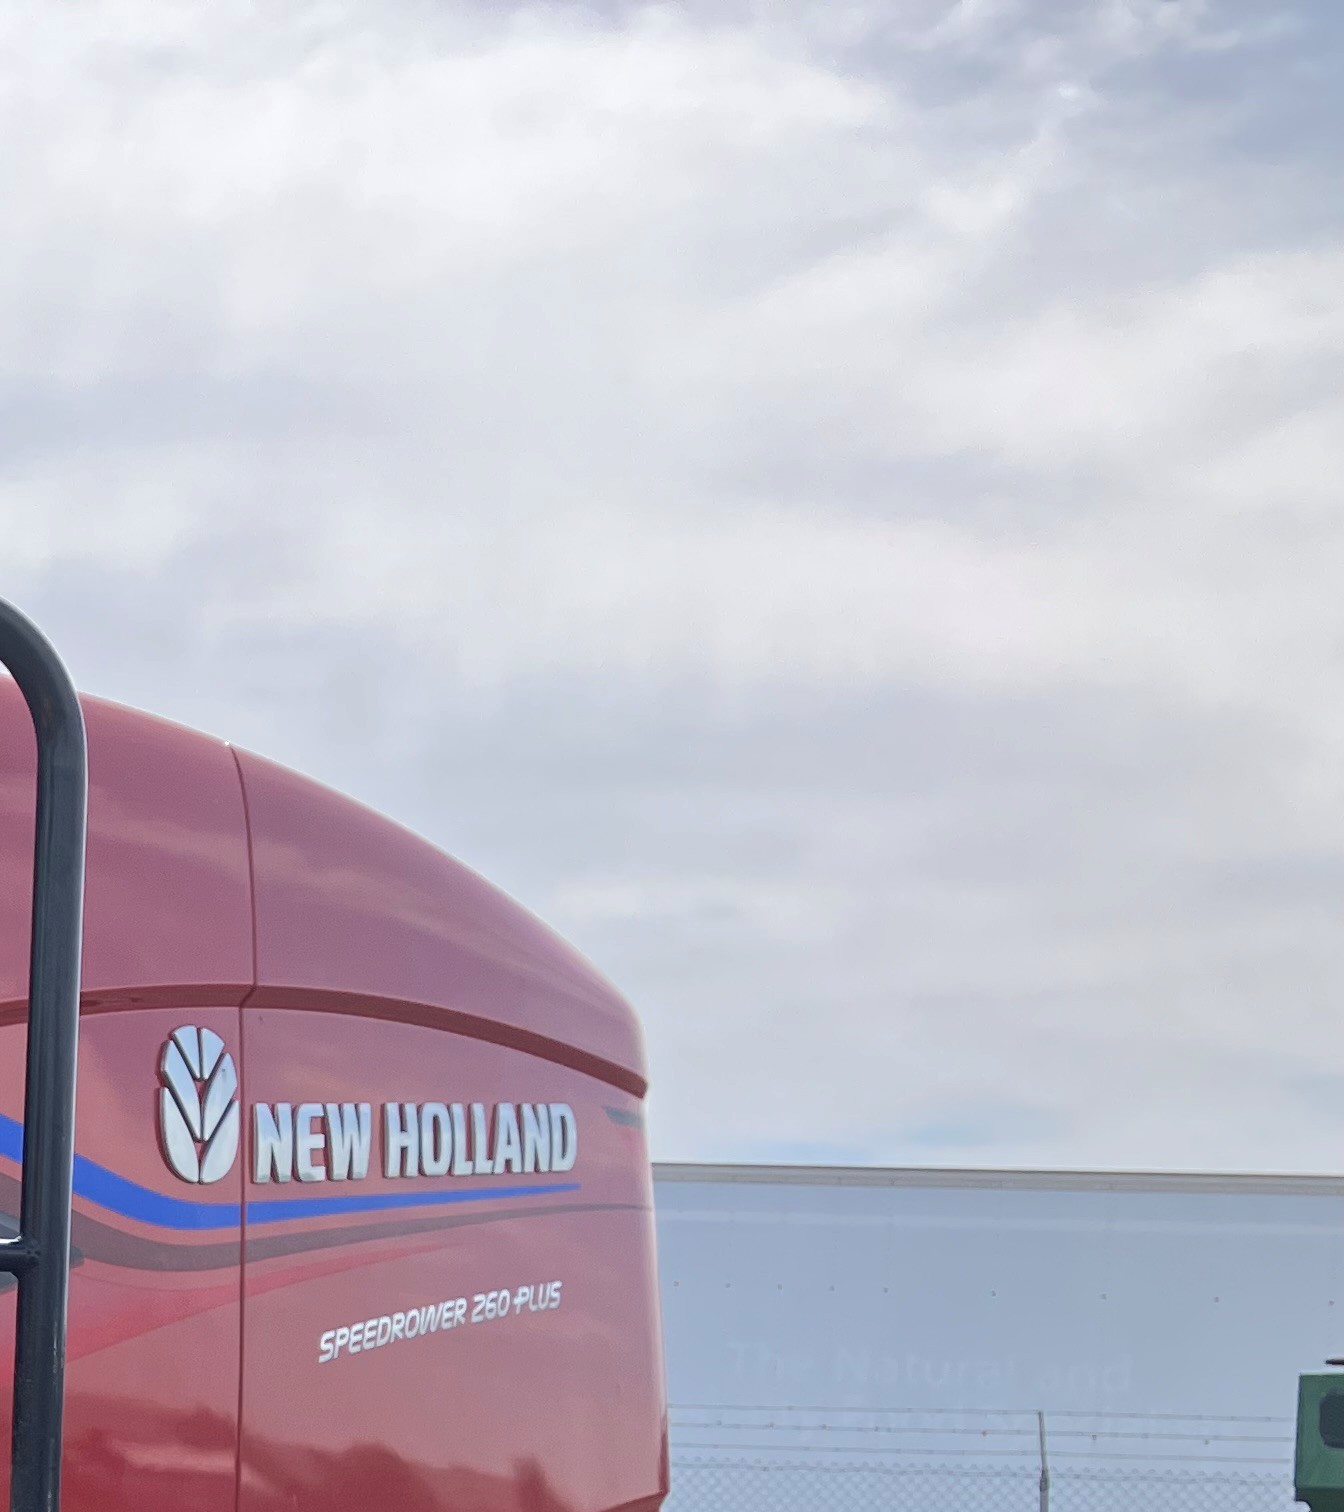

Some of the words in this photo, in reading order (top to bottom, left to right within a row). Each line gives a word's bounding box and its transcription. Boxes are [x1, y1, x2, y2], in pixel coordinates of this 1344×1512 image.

[251, 1101, 372, 1185] NEW
[381, 1101, 578, 1179] HOLLAND
[318, 1296, 467, 1364] SPEEDROWER
[471, 1288, 511, 1324] 260
